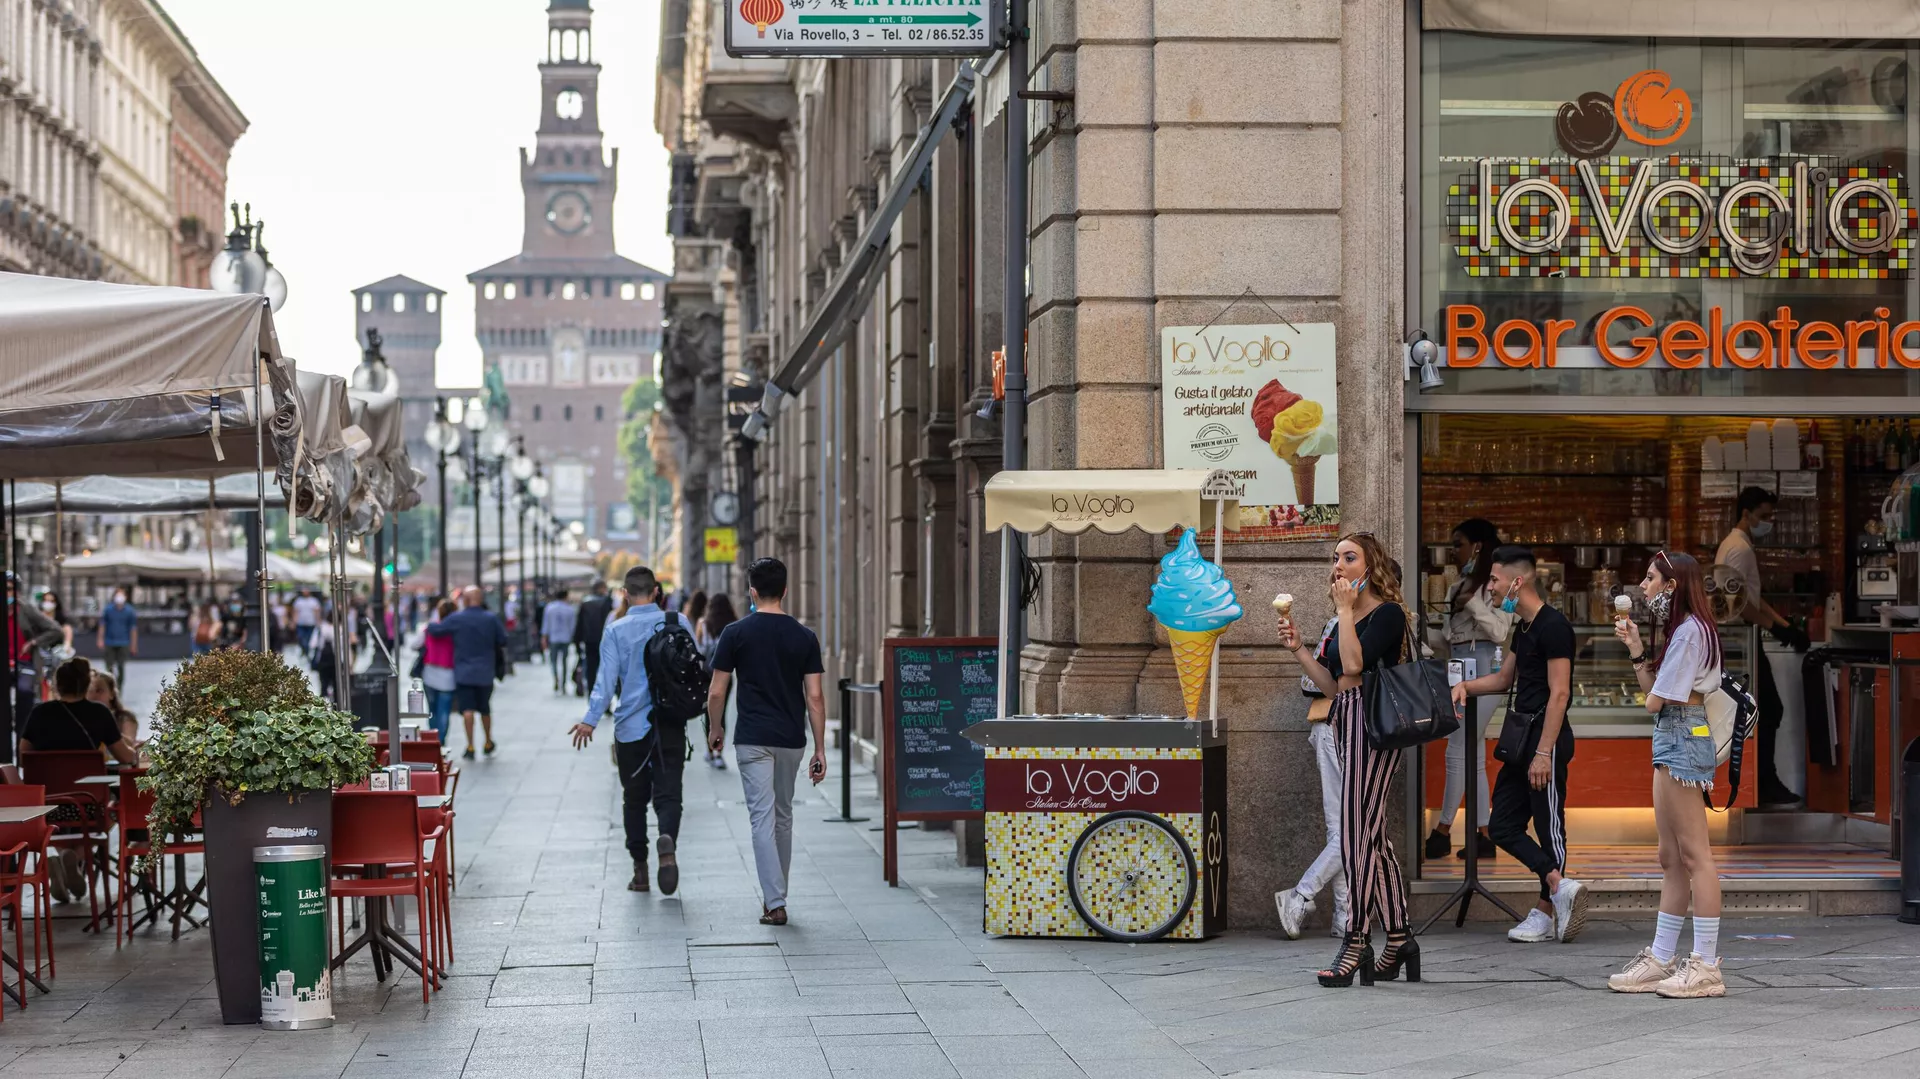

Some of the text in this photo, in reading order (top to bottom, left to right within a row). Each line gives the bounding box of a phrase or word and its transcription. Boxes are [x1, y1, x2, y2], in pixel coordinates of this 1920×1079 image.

[901, 16, 913, 24] 80
[774, 29, 794, 41] Via
[800, 28, 849, 42] Rovello,
[881, 29, 902, 41] Tel.
[1446, 304, 1576, 369] Bar
[1172, 335, 1291, 368] la Voglia
[1174, 385, 1253, 401] Gusta il gelato
[1183, 402, 1245, 418] artigianale!
[1191, 437, 1238, 449] PREMIUM QUALITY
[1051, 494, 1135, 518] la Voglia
[900, 684, 937, 698] GELATO
[901, 712, 944, 727] APERITIVI
[1026, 763, 1160, 802] la Voglia
[1026, 796, 1107, 809] Italian Ice Cream
[297, 888, 319, 900] Like
